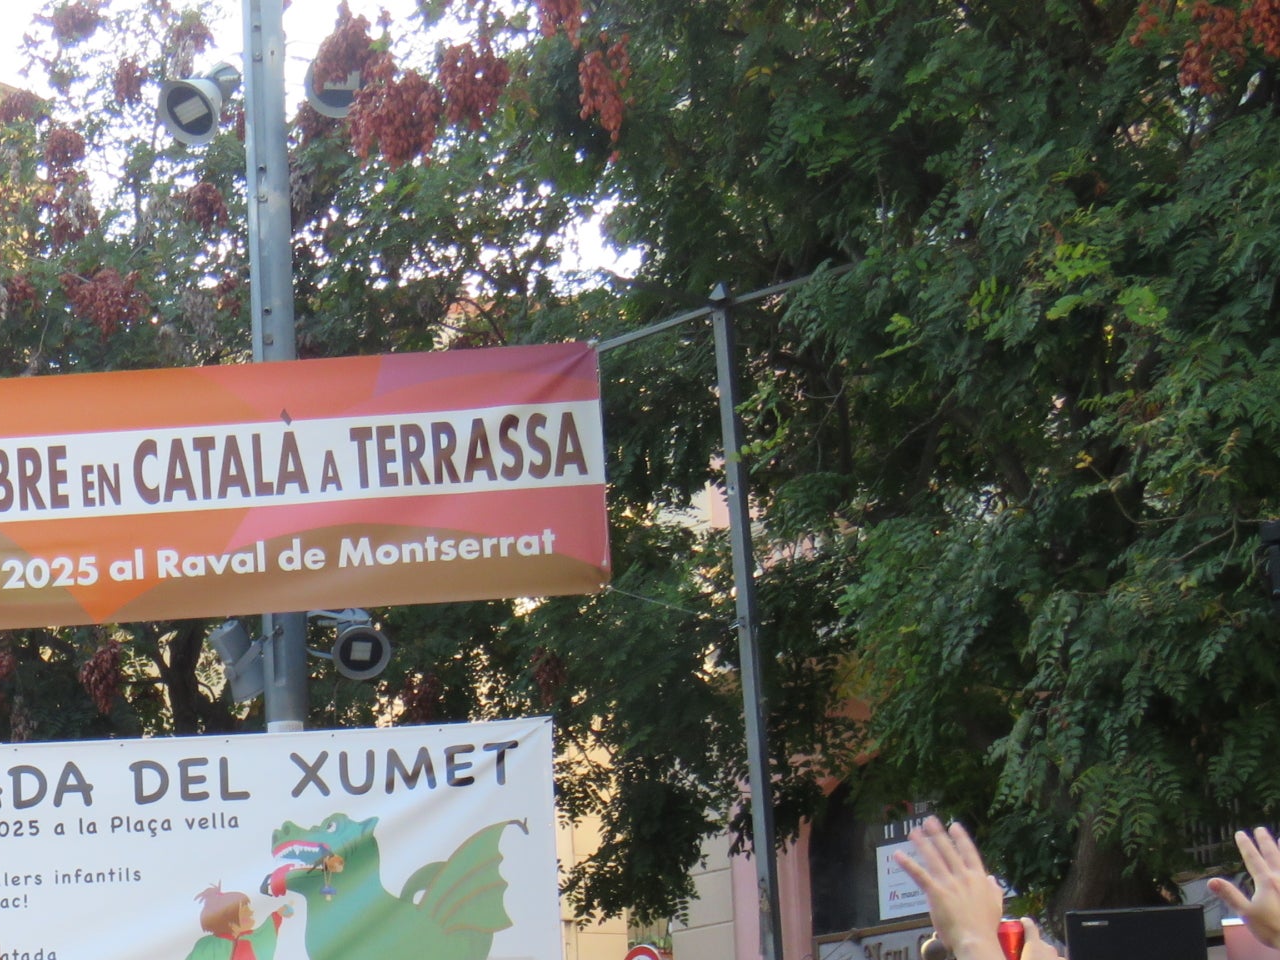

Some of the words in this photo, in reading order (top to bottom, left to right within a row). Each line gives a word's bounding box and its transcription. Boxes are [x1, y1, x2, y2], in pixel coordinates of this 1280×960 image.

[82, 464, 120, 508] EN
[133, 408, 309, 505] CATALÀ
[320, 449, 342, 492] A
[349, 412, 588, 490] TERRASSA
[1, 556, 99, 590] 2025
[109, 549, 144, 581] al
[156, 541, 265, 578] Raval
[278, 538, 326, 570] de
[339, 529, 555, 568] Montserrat
[129, 756, 251, 805] DEL
[290, 740, 519, 799] XUMET
[53, 821, 65, 836] a
[79, 818, 97, 835] la
[111, 816, 172, 838] Plaça
[185, 813, 239, 831] vella
[54, 868, 141, 885] infantils
